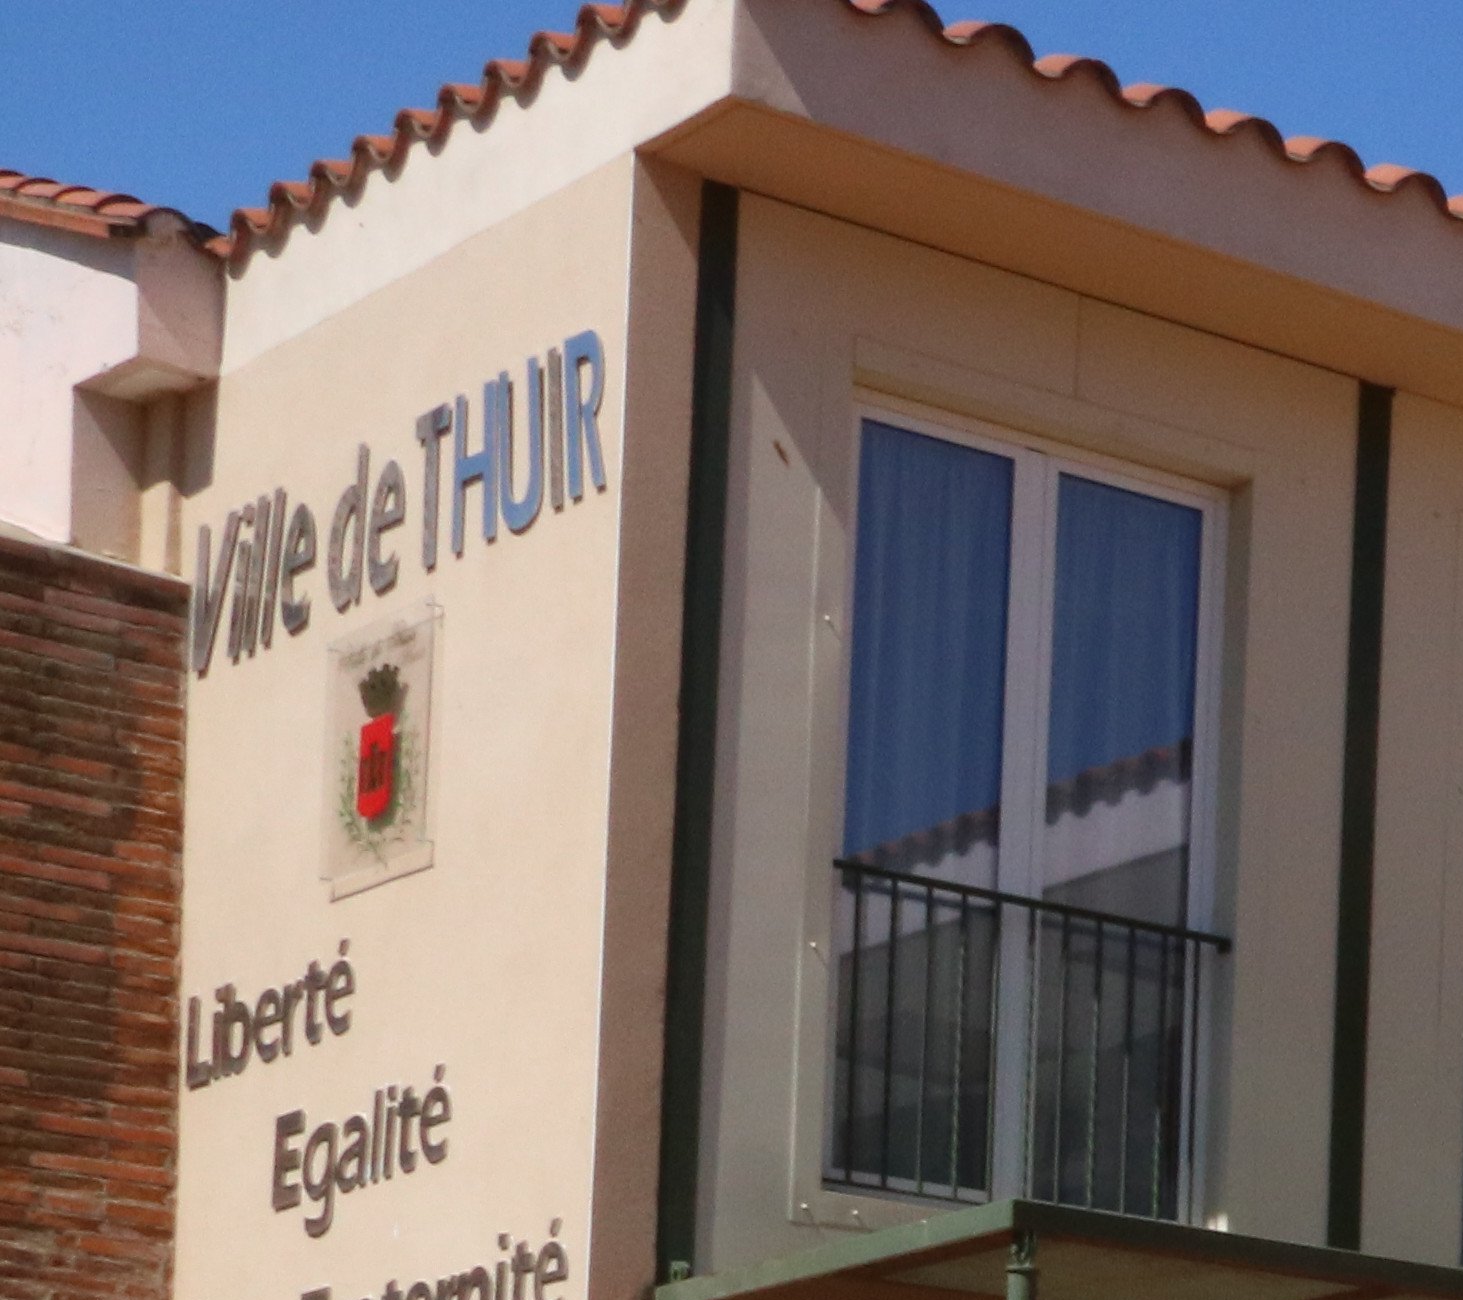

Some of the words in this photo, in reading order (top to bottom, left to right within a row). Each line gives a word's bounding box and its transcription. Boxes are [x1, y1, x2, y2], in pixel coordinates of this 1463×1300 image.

[190, 487, 317, 679] Ville
[327, 443, 406, 614] de
[415, 329, 607, 574] THUIR
[185, 939, 356, 1091] Liberté
[270, 1063, 452, 1238] Egalité
